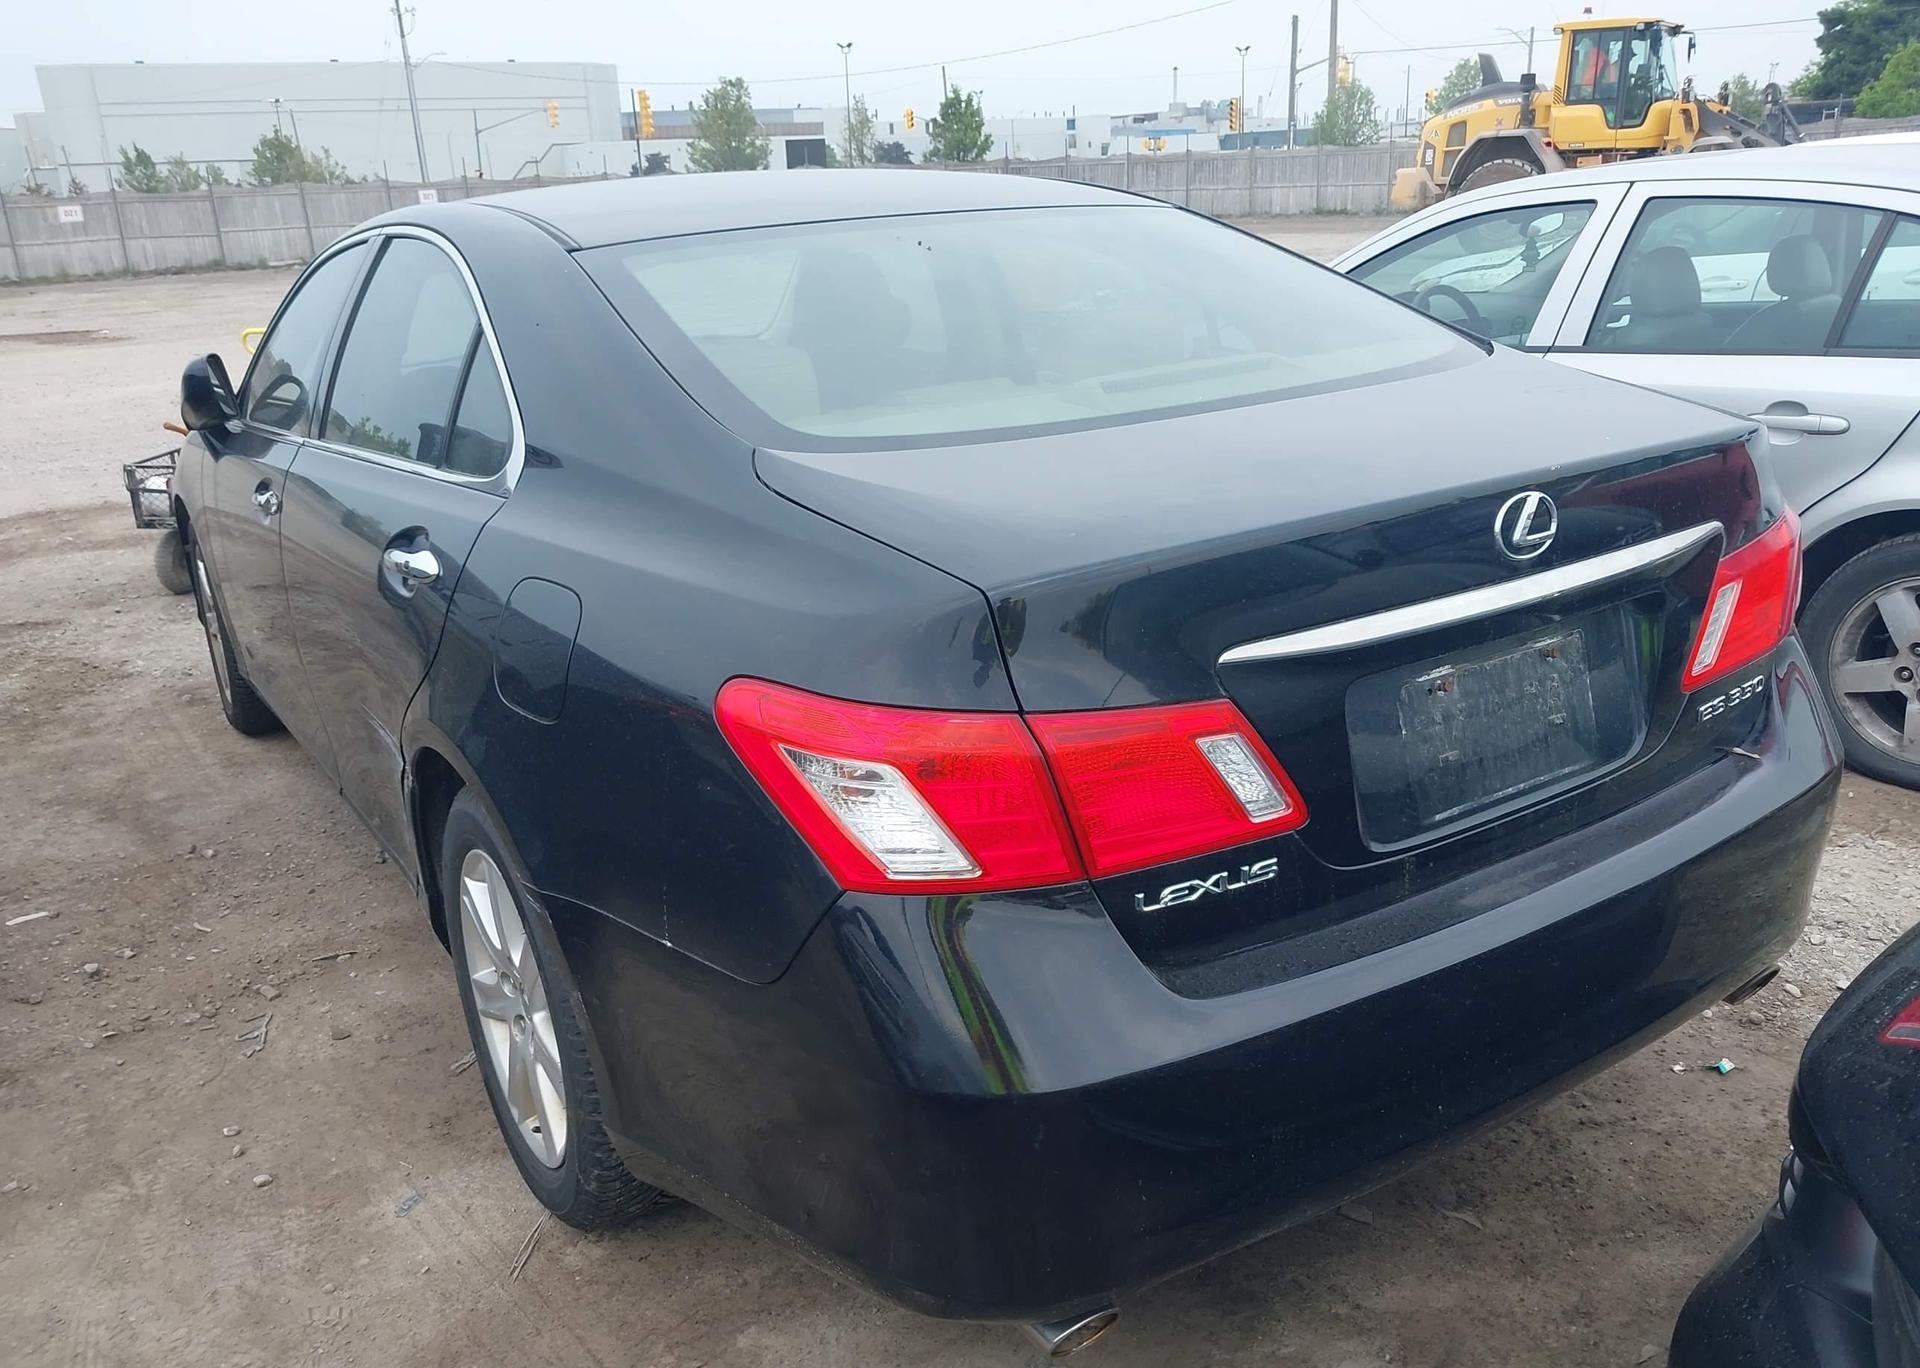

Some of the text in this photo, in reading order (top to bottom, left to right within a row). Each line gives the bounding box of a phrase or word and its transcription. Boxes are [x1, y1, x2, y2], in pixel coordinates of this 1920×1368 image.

[1697, 675, 1764, 721] ES 350
[1134, 857, 1279, 912] LEXUS
